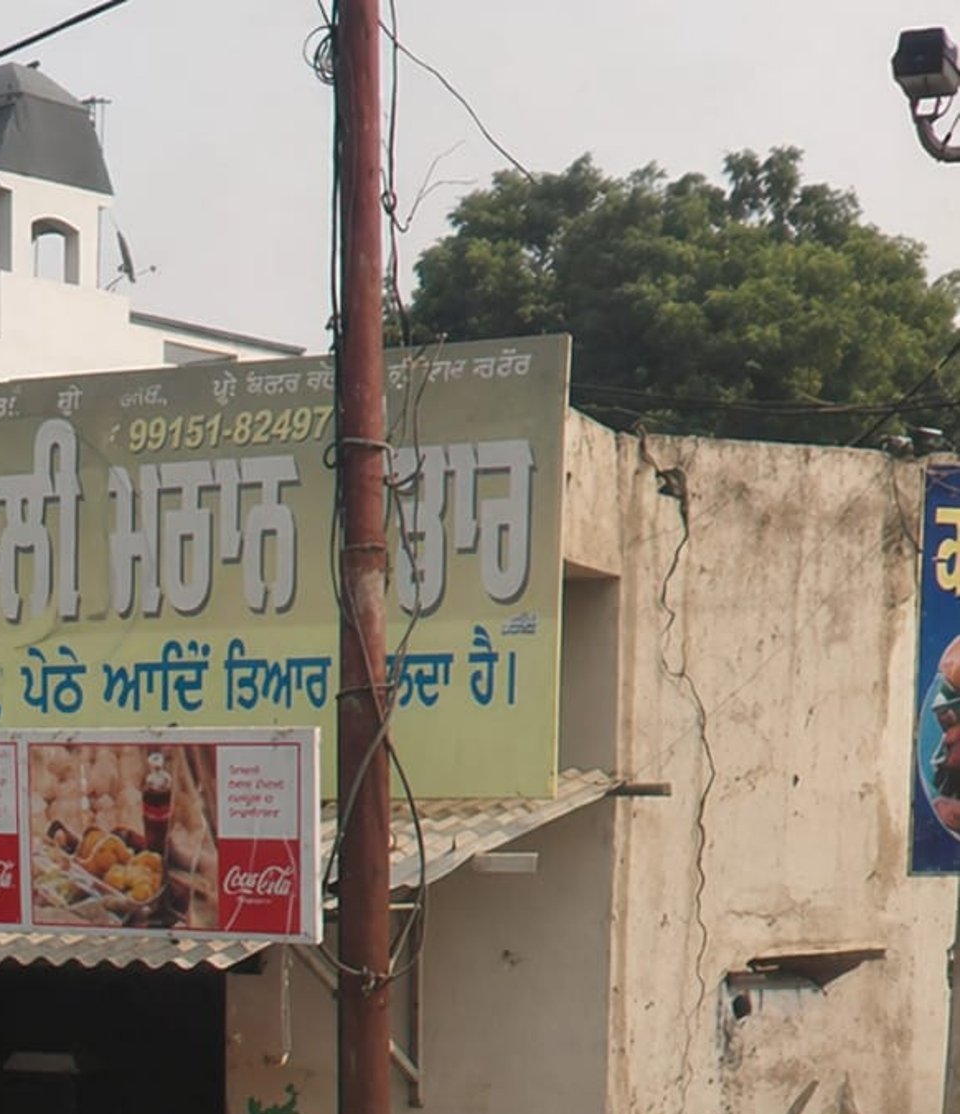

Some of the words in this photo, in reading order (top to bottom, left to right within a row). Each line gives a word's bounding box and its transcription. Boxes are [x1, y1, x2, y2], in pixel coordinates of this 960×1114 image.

[128, 404, 334, 454] 99151-82497
[20, 645, 87, 714] ਪੇਠੇ
[223, 637, 332, 711] ਤਿਆਰ
